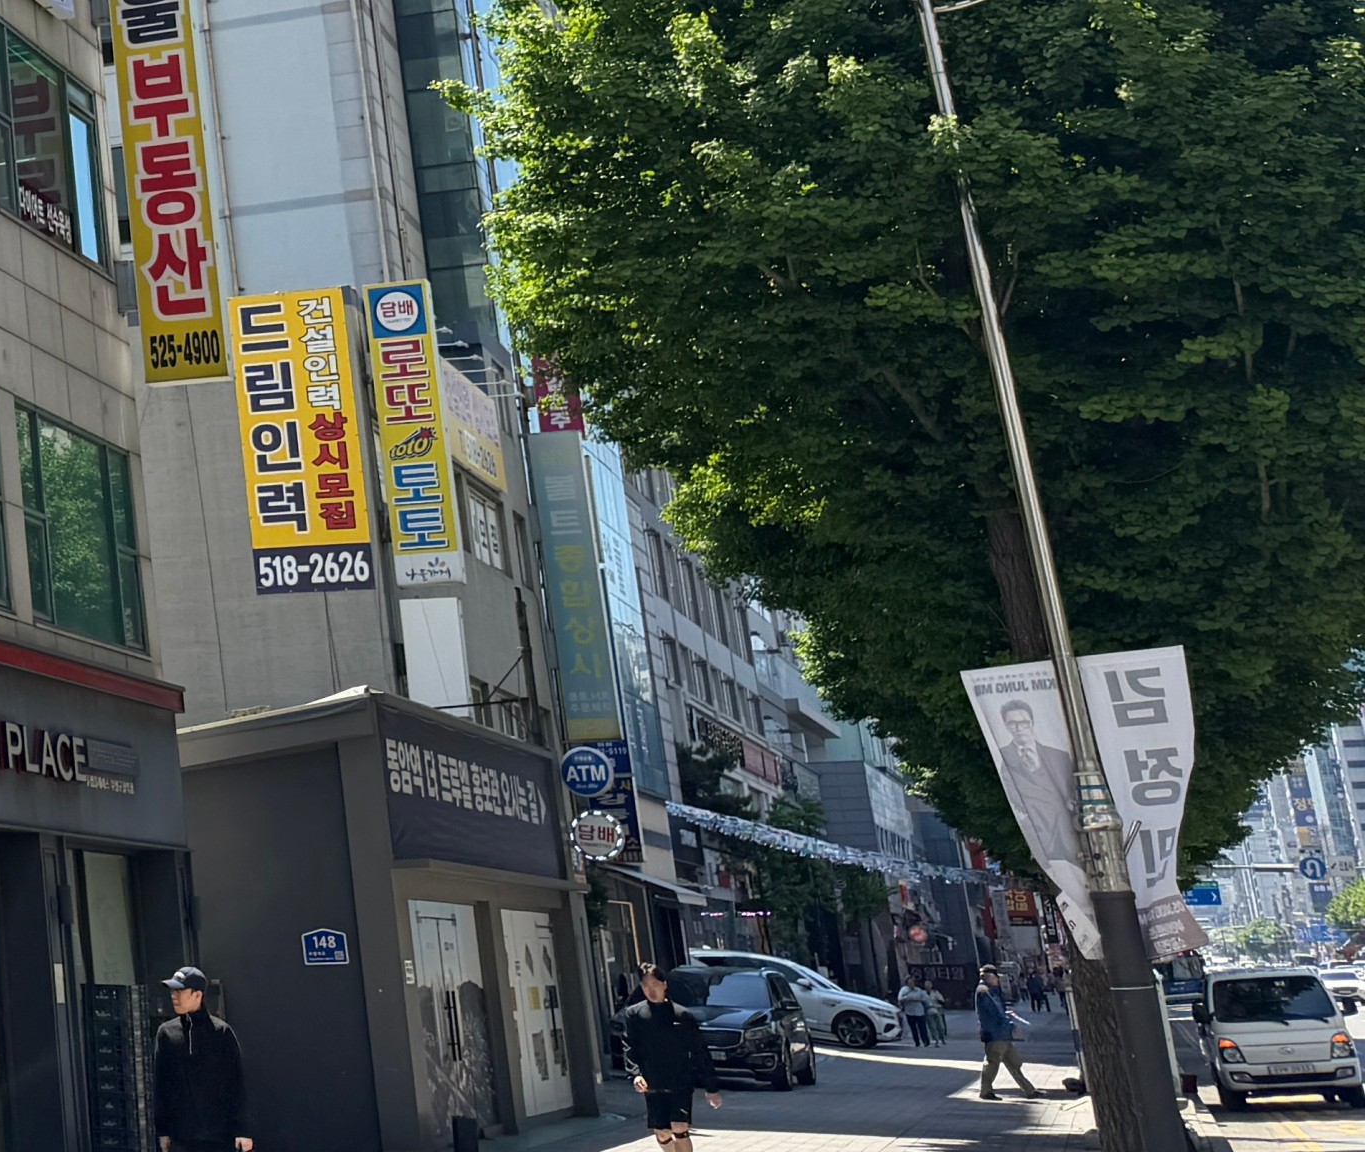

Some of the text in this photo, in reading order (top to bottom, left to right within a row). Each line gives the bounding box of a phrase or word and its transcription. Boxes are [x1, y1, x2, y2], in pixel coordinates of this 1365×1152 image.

[19, 186, 46, 225] 다이어트
[380, 299, 414, 318] 담배
[150, 329, 221, 369] 525-4900
[380, 339, 436, 425] 로또
[238, 303, 308, 535] 드림인력
[297, 297, 357, 530] 건설인력 상시모집
[393, 463, 449, 551] 토토
[258, 549, 370, 588] 518-2626
[6, 721, 87, 782] PLACE
[386, 738, 425, 798] 동암역
[566, 765, 606, 782] ATM
[578, 824, 616, 842] 담배
[312, 936, 336, 948] 148
